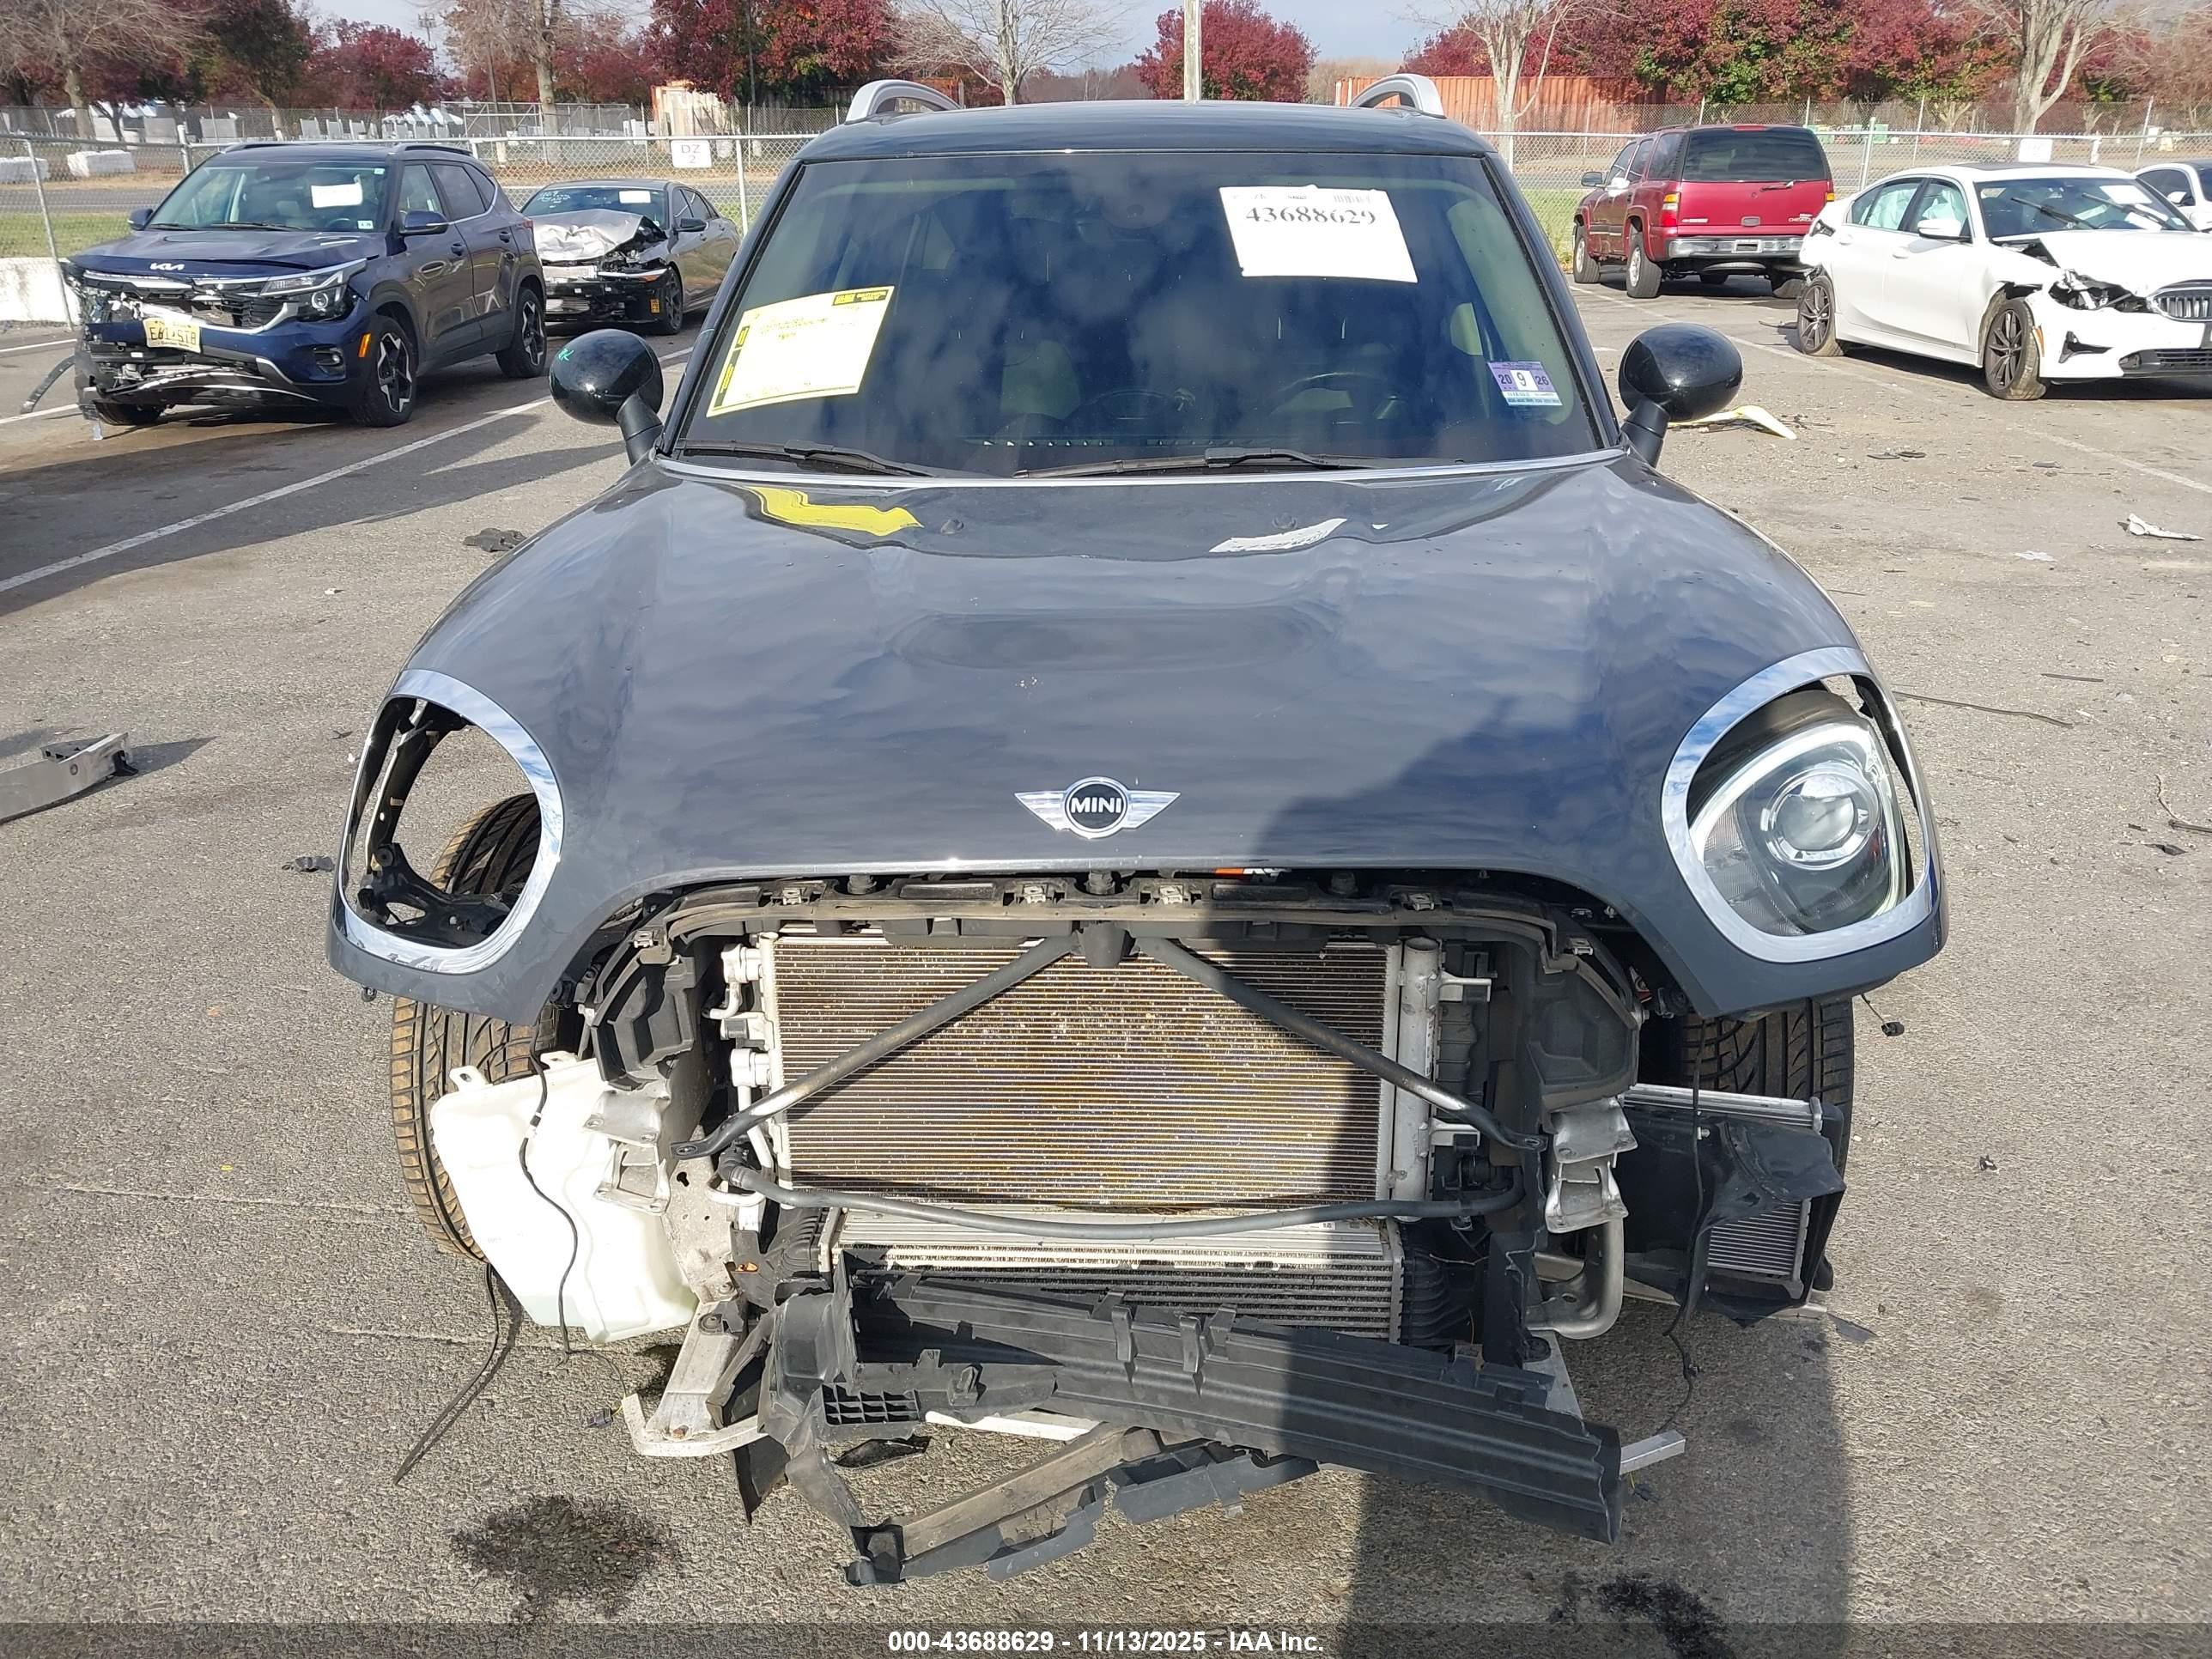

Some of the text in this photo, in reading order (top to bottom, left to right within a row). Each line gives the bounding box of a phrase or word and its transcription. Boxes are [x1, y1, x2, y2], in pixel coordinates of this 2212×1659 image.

[681, 144, 701, 153] DZ
[688, 155, 696, 164] 2
[1245, 206, 1376, 224] 43688629
[1498, 372, 1549, 386] 20 9 26
[1071, 797, 1122, 813] MINI
